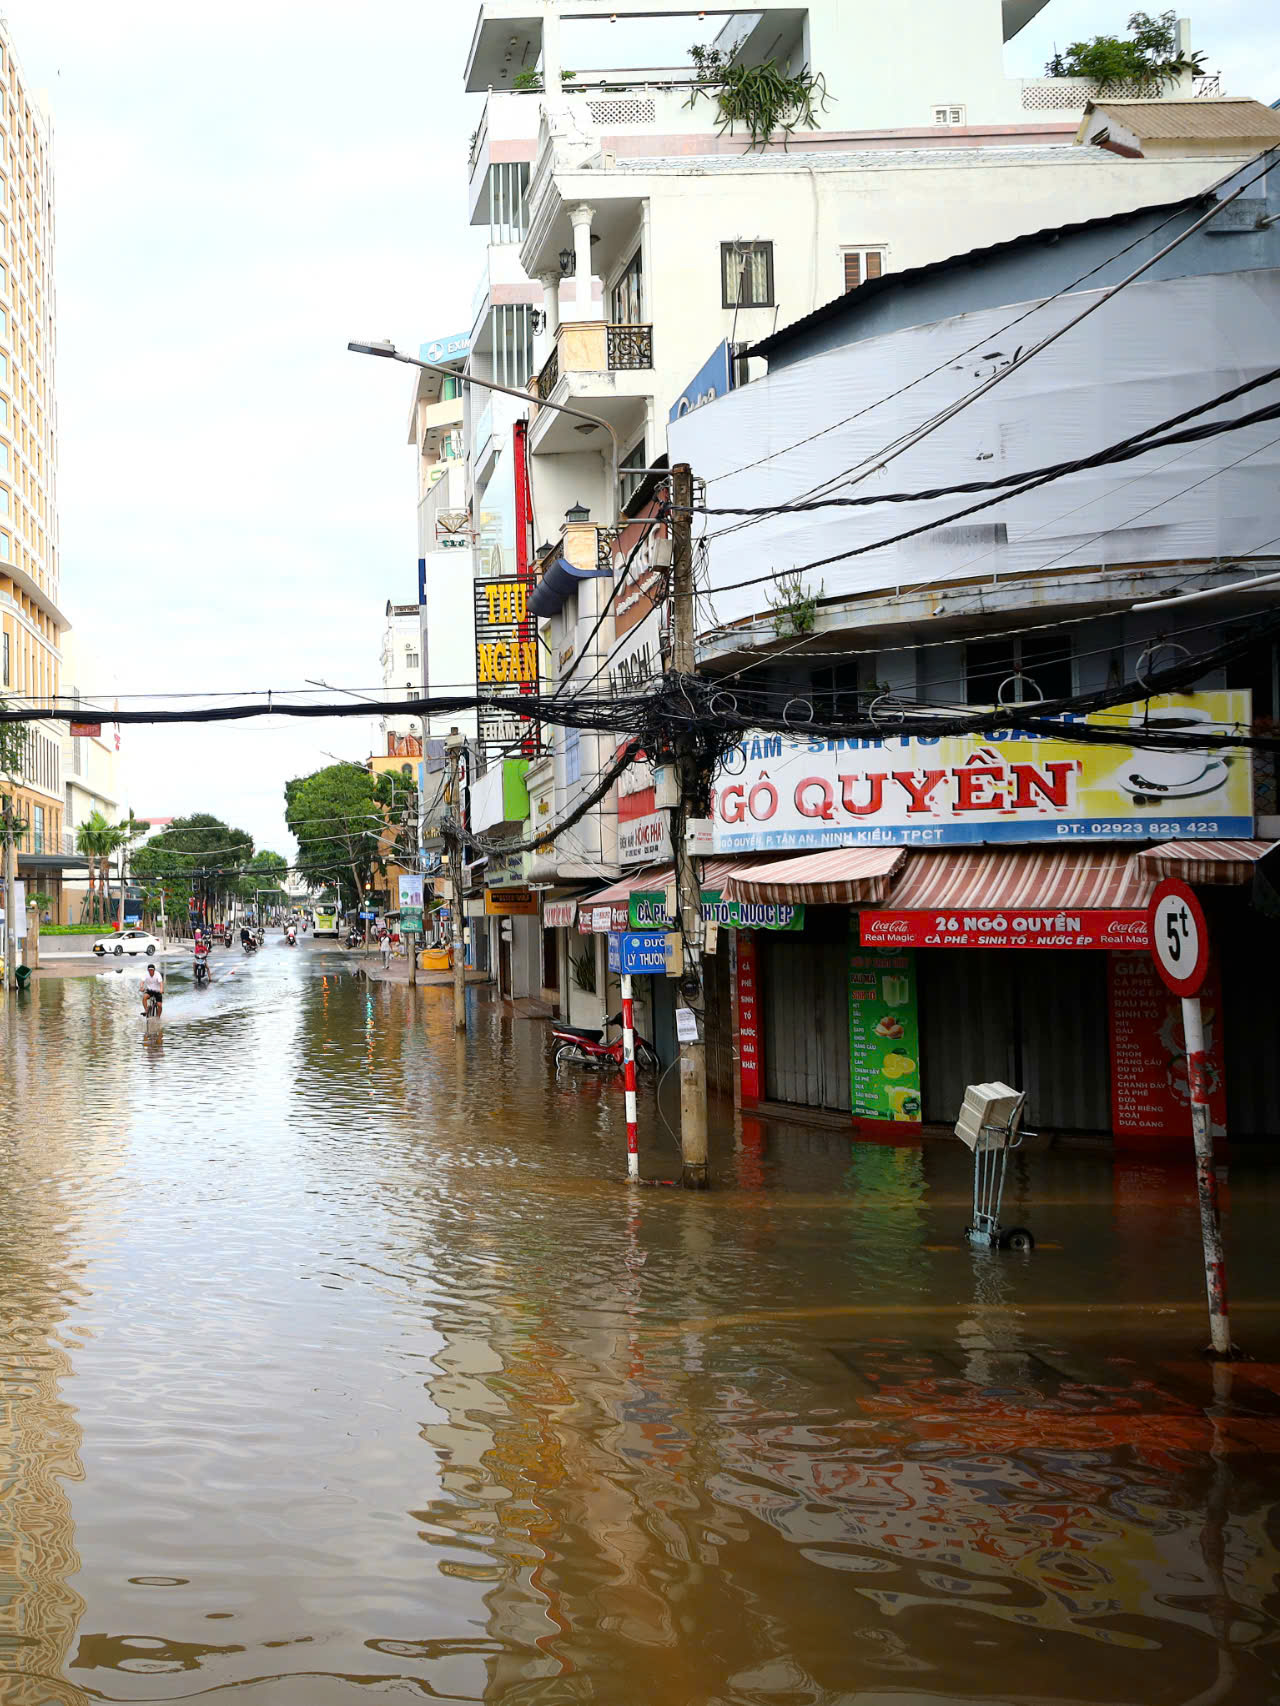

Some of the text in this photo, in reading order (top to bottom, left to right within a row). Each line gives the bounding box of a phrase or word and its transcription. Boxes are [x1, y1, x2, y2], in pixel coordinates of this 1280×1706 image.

[485, 584, 527, 624] THU
[477, 629, 537, 683] NGÂN
[710, 771, 779, 823] GÔ
[794, 747, 1078, 821] QUYỀN
[821, 831, 853, 844] NINH
[901, 828, 944, 841] TPCT
[1057, 822, 1219, 834] ĐT: 02923 823 423
[637, 900, 652, 922] CÀ
[654, 904, 673, 923] PH
[935, 911, 1082, 932] 26 NGÔ QUYỀN
[865, 933, 915, 943] Real Magic
[925, 933, 942, 945] CÀ
[944, 934, 968, 945] PHÊ
[978, 935, 1007, 945] SINH
[1100, 935, 1149, 945] Real Mag
